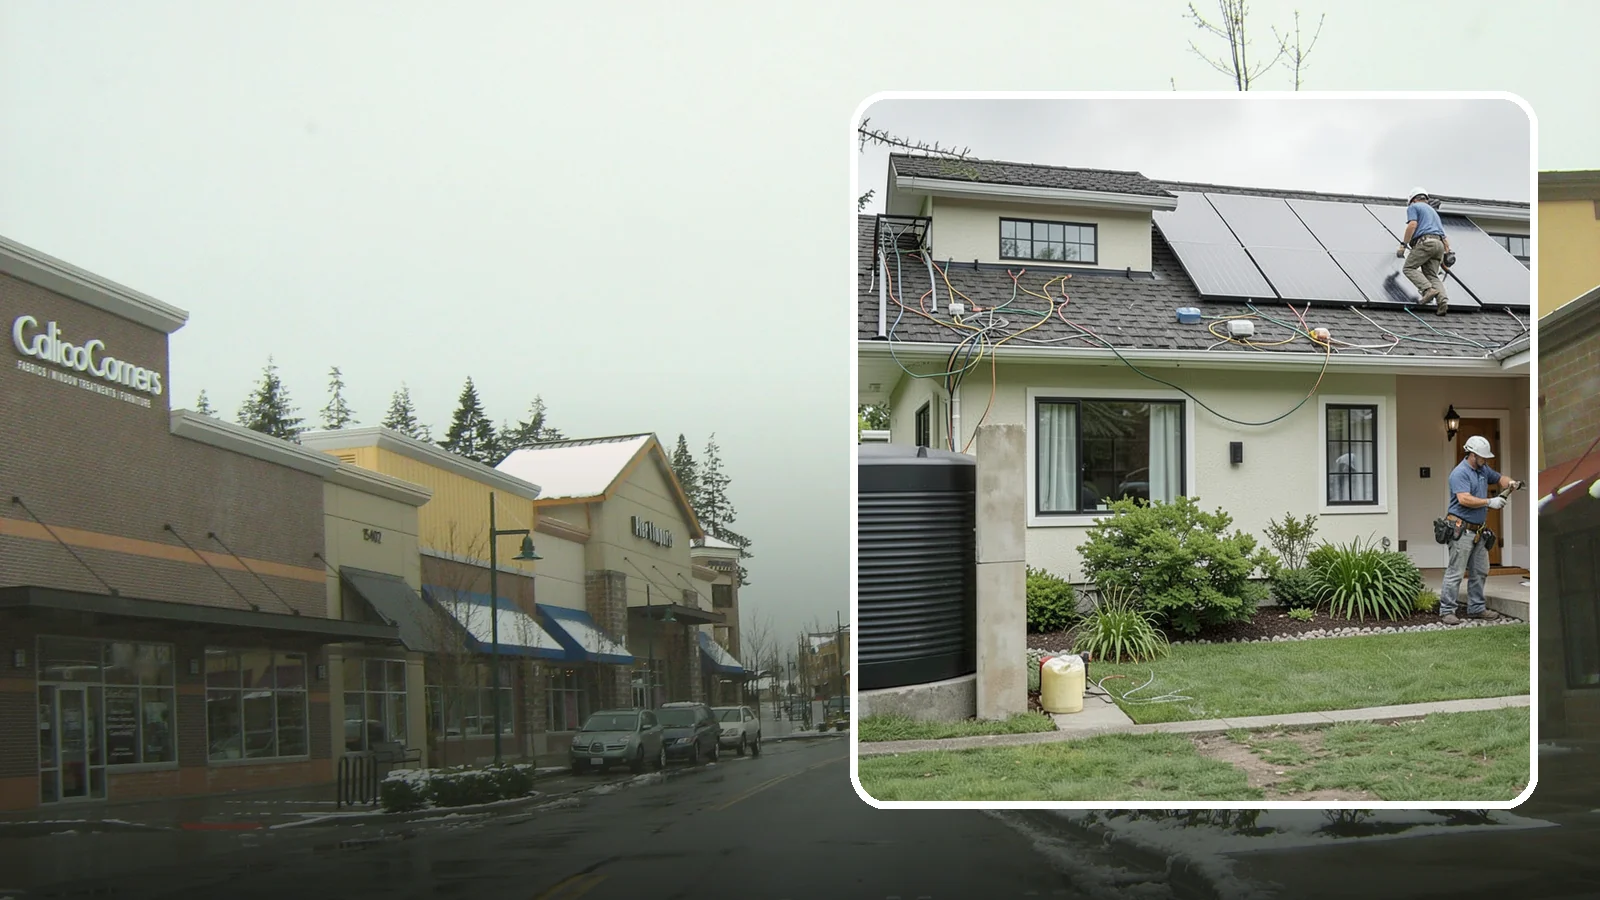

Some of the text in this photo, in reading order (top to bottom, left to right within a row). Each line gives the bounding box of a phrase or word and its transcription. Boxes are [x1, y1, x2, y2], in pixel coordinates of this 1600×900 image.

[17, 360, 151, 408] FABRICS WINDOW TREATMENTS FURNITURE
